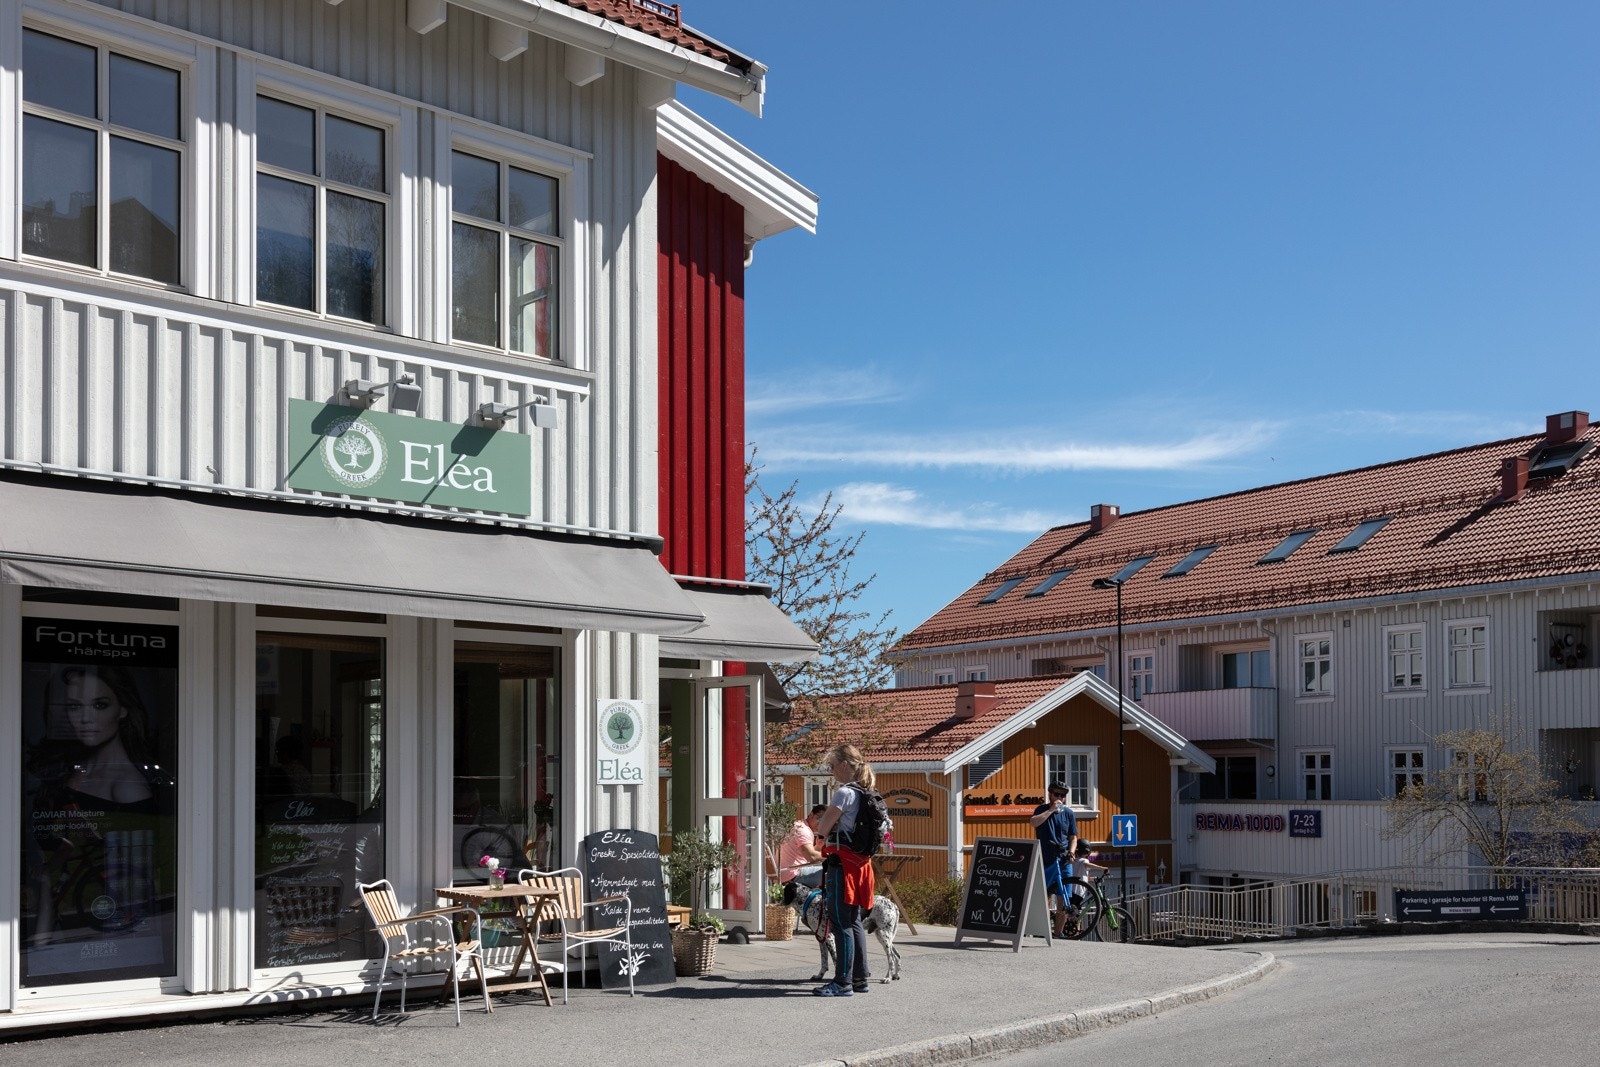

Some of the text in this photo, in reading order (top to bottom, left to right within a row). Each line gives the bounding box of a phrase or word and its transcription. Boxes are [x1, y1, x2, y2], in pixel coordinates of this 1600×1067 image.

[338, 421, 370, 435] PURELY
[399, 440, 498, 493] Eléa
[340, 470, 368, 482] GREEK
[35, 625, 166, 649] Fortuna
[610, 706, 632, 715] PURELY
[611, 743, 630, 751] GREEK
[598, 758, 644, 781] Eléa
[964, 793, 1045, 806] Smak & Sans
[32, 810, 105, 819] CAVIAR Moisture
[1293, 814, 1315, 826] 7-23
[32, 822, 98, 833] younger-looking
[1195, 813, 1284, 833] REMA 1000
[590, 847, 617, 863] Greske
[976, 864, 1023, 879] GLUTENFRI
[641, 878, 656, 887] mat
[978, 876, 1001, 887] PASTA
[1402, 897, 1428, 905] Parkering
[601, 902, 623, 916] Kalde
[632, 906, 651, 914] varme
[970, 909, 985, 921] NÅ
[609, 940, 664, 952] Velkmmen inn
